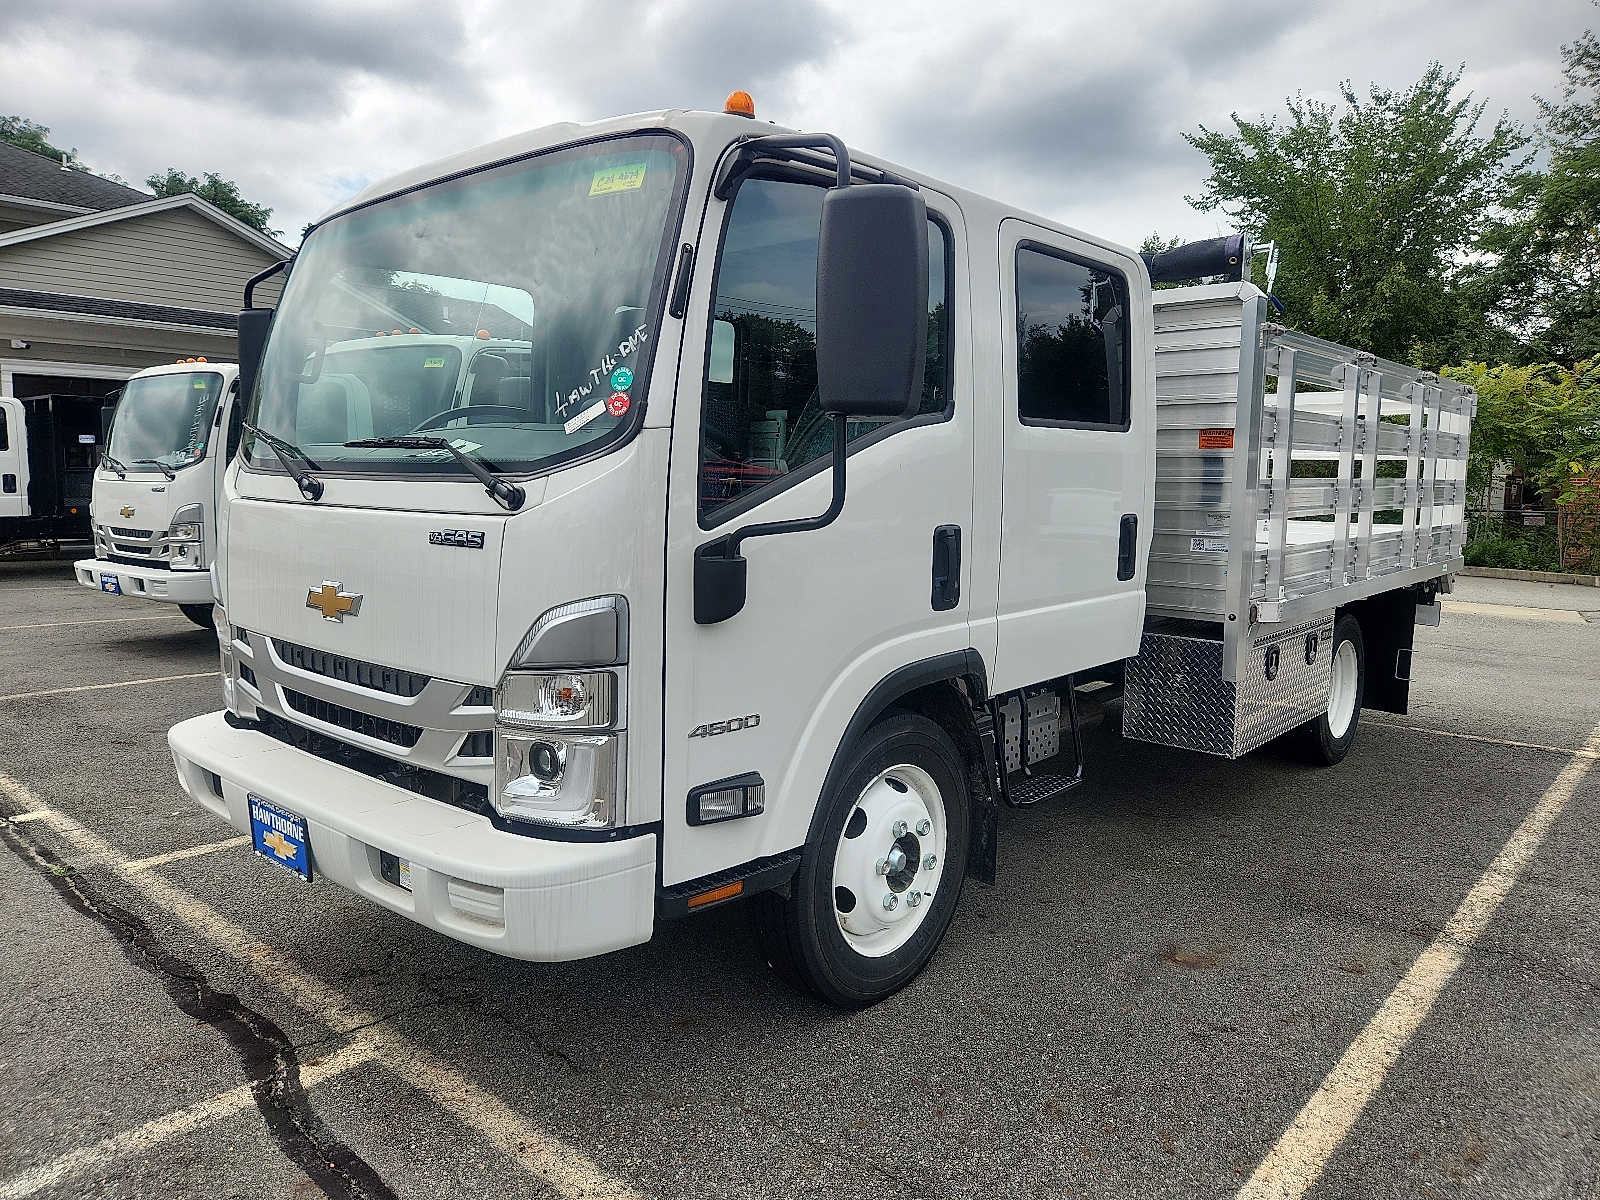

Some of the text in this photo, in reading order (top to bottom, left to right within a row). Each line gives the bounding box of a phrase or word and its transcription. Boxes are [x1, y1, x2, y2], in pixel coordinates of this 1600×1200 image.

[442, 530, 483, 547] GAS
[688, 713, 761, 738] 4500
[252, 804, 305, 843] HAWTHORNE
